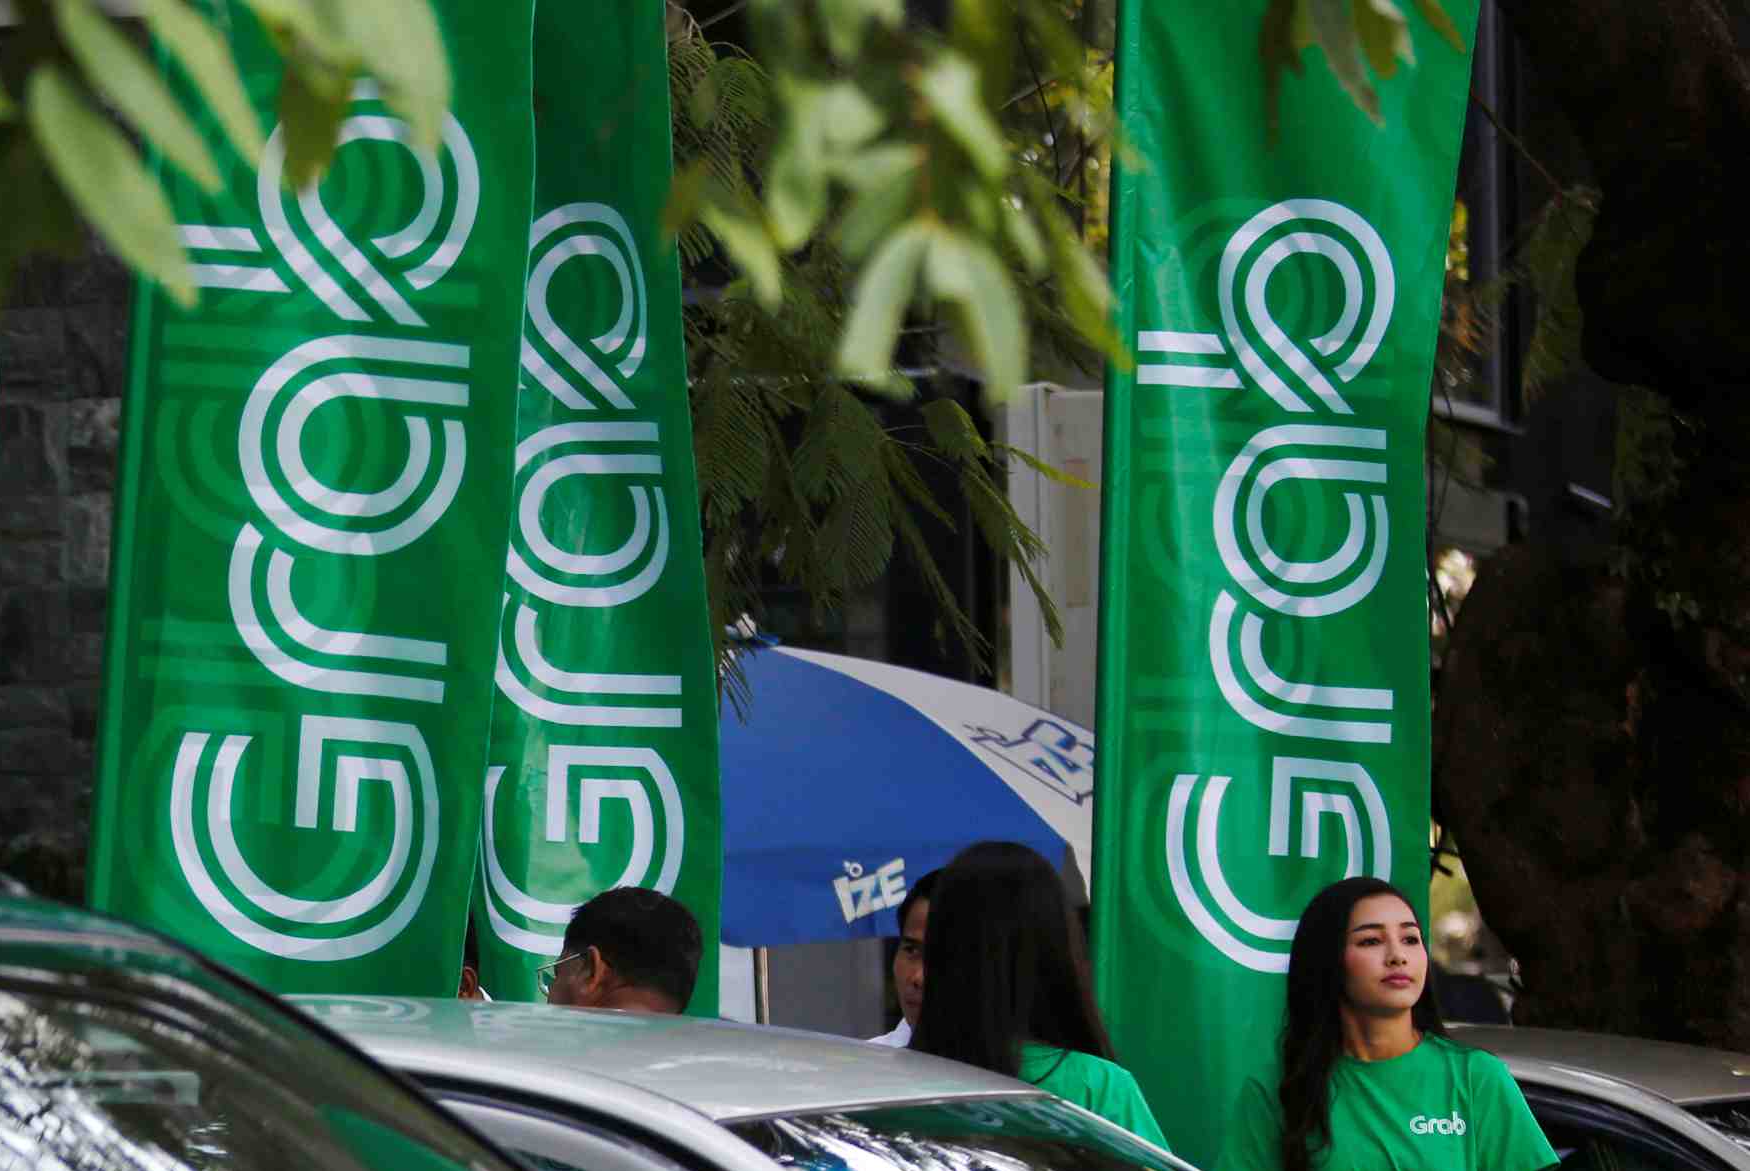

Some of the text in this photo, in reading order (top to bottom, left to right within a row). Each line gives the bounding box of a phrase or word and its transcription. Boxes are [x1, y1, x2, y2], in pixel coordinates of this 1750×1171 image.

[170, 77, 480, 962] Grab
[481, 202, 684, 956] Grab
[1137, 198, 1395, 974] Grab
[1410, 1111, 1466, 1136] Grab
